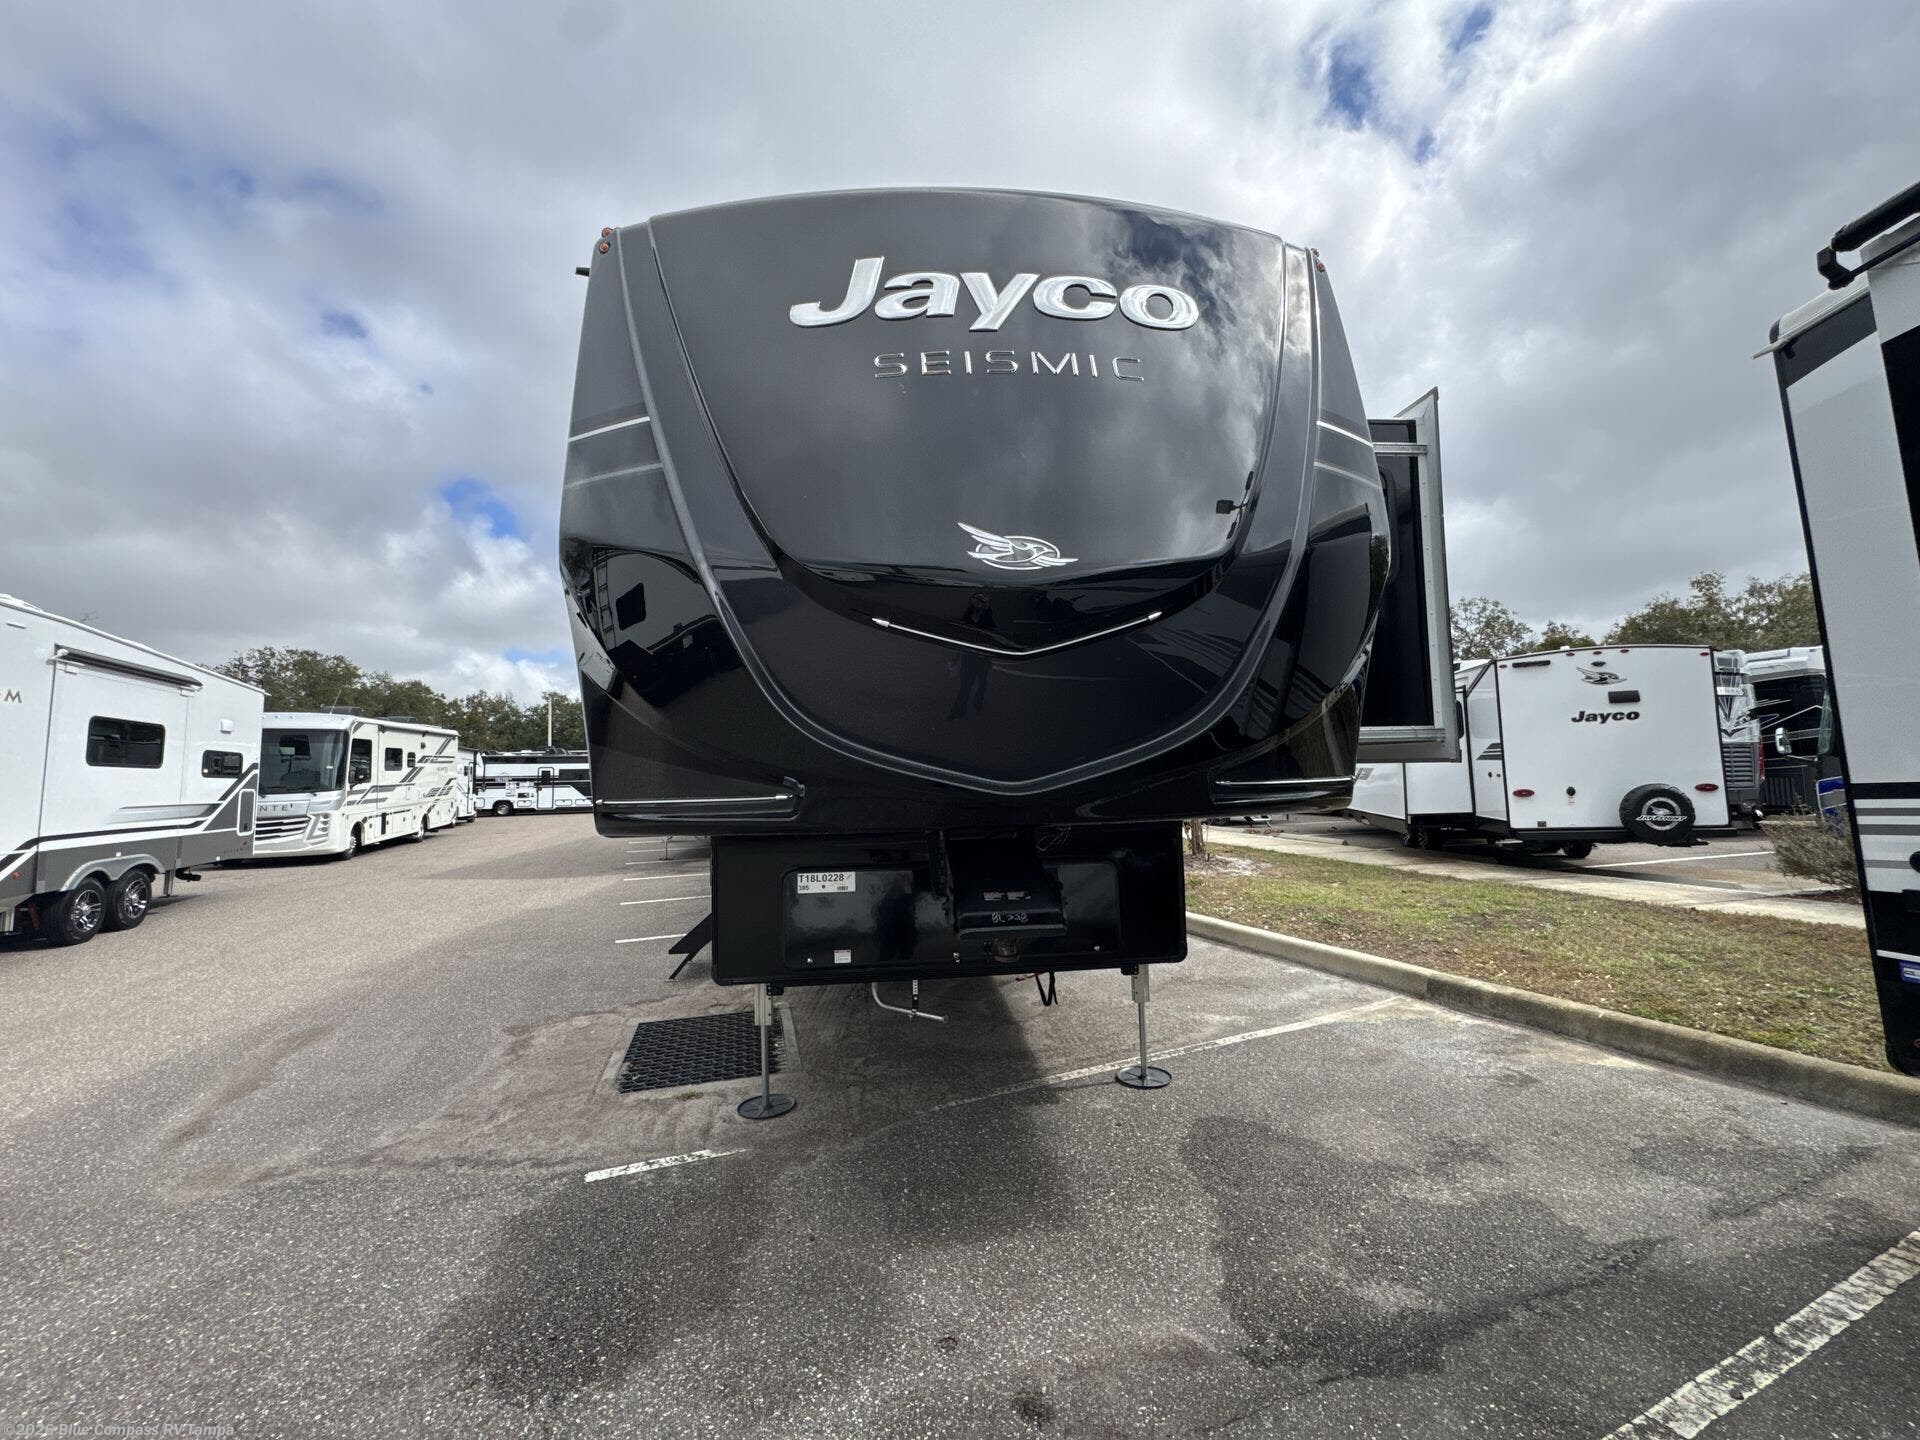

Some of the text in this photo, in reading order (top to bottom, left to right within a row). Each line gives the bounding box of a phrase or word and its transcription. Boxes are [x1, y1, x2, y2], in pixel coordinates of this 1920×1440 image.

[789, 255, 1200, 332] Jayco
[874, 350, 1145, 382] SEISMIC
[1571, 710, 1640, 724] Jayco
[798, 873, 845, 883] T18L0228
